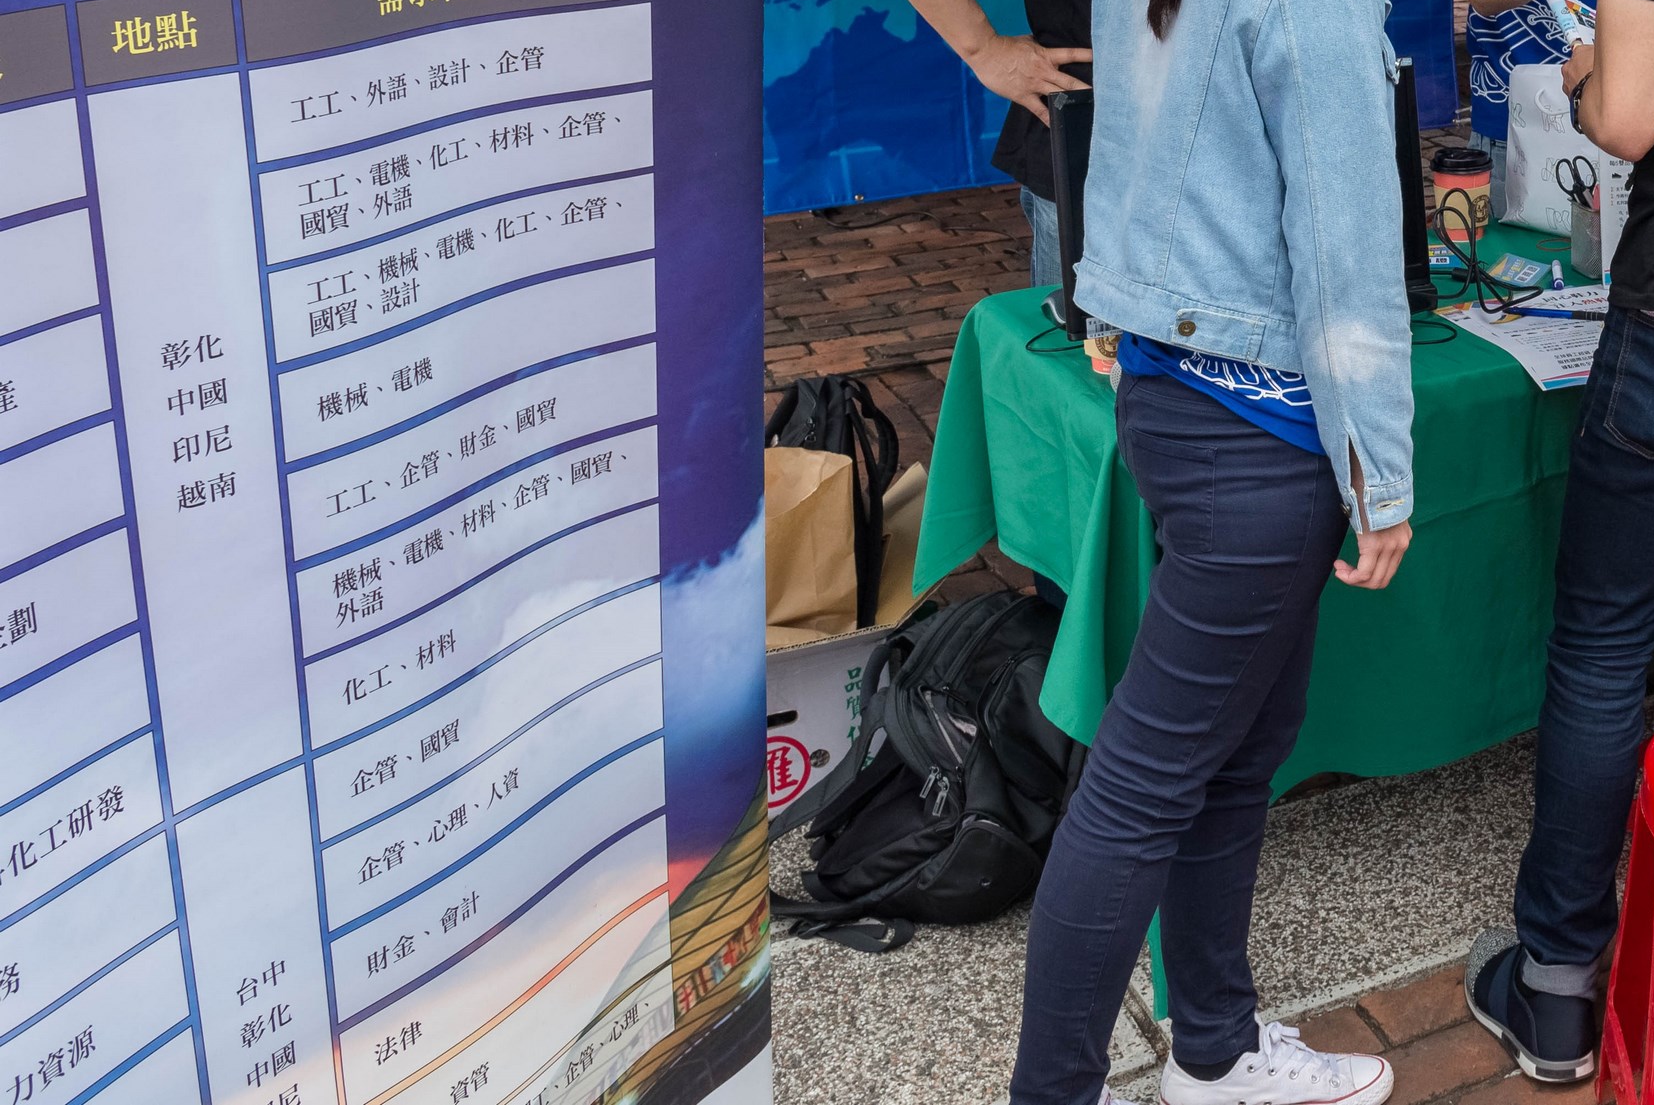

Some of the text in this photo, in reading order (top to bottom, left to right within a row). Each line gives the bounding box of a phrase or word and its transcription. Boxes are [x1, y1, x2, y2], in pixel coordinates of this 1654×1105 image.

[111, 10, 198, 55] 地點
[160, 334, 224, 371] 彰化
[168, 378, 228, 416] 中國
[173, 425, 233, 464] 印尼
[177, 472, 236, 513] 越南
[0, 602, 38, 653] 劃
[336, 587, 384, 628] 外語
[0, 785, 125, 886] 化工研發
[236, 960, 286, 1006] 台中
[240, 1003, 293, 1049] 彰化
[374, 1021, 423, 1066] 法律
[246, 1041, 297, 1089] 中國
[450, 1061, 490, 1105] 資管
